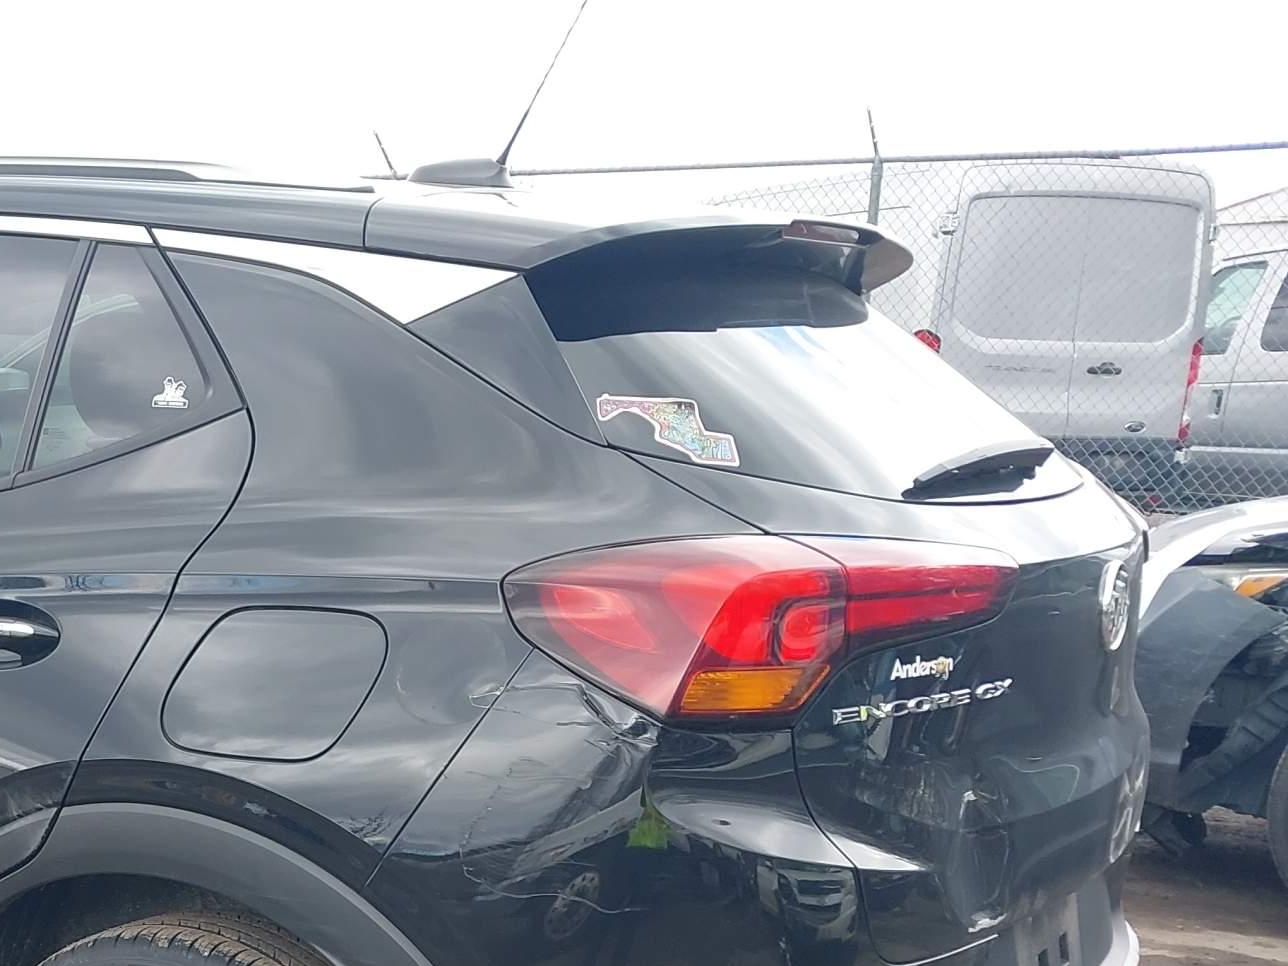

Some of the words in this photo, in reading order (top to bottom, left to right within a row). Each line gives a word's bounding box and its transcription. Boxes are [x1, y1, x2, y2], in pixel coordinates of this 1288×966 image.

[890, 655, 954, 681] Anderson
[832, 688, 972, 726] ENCORE
[975, 678, 1013, 700] GX
